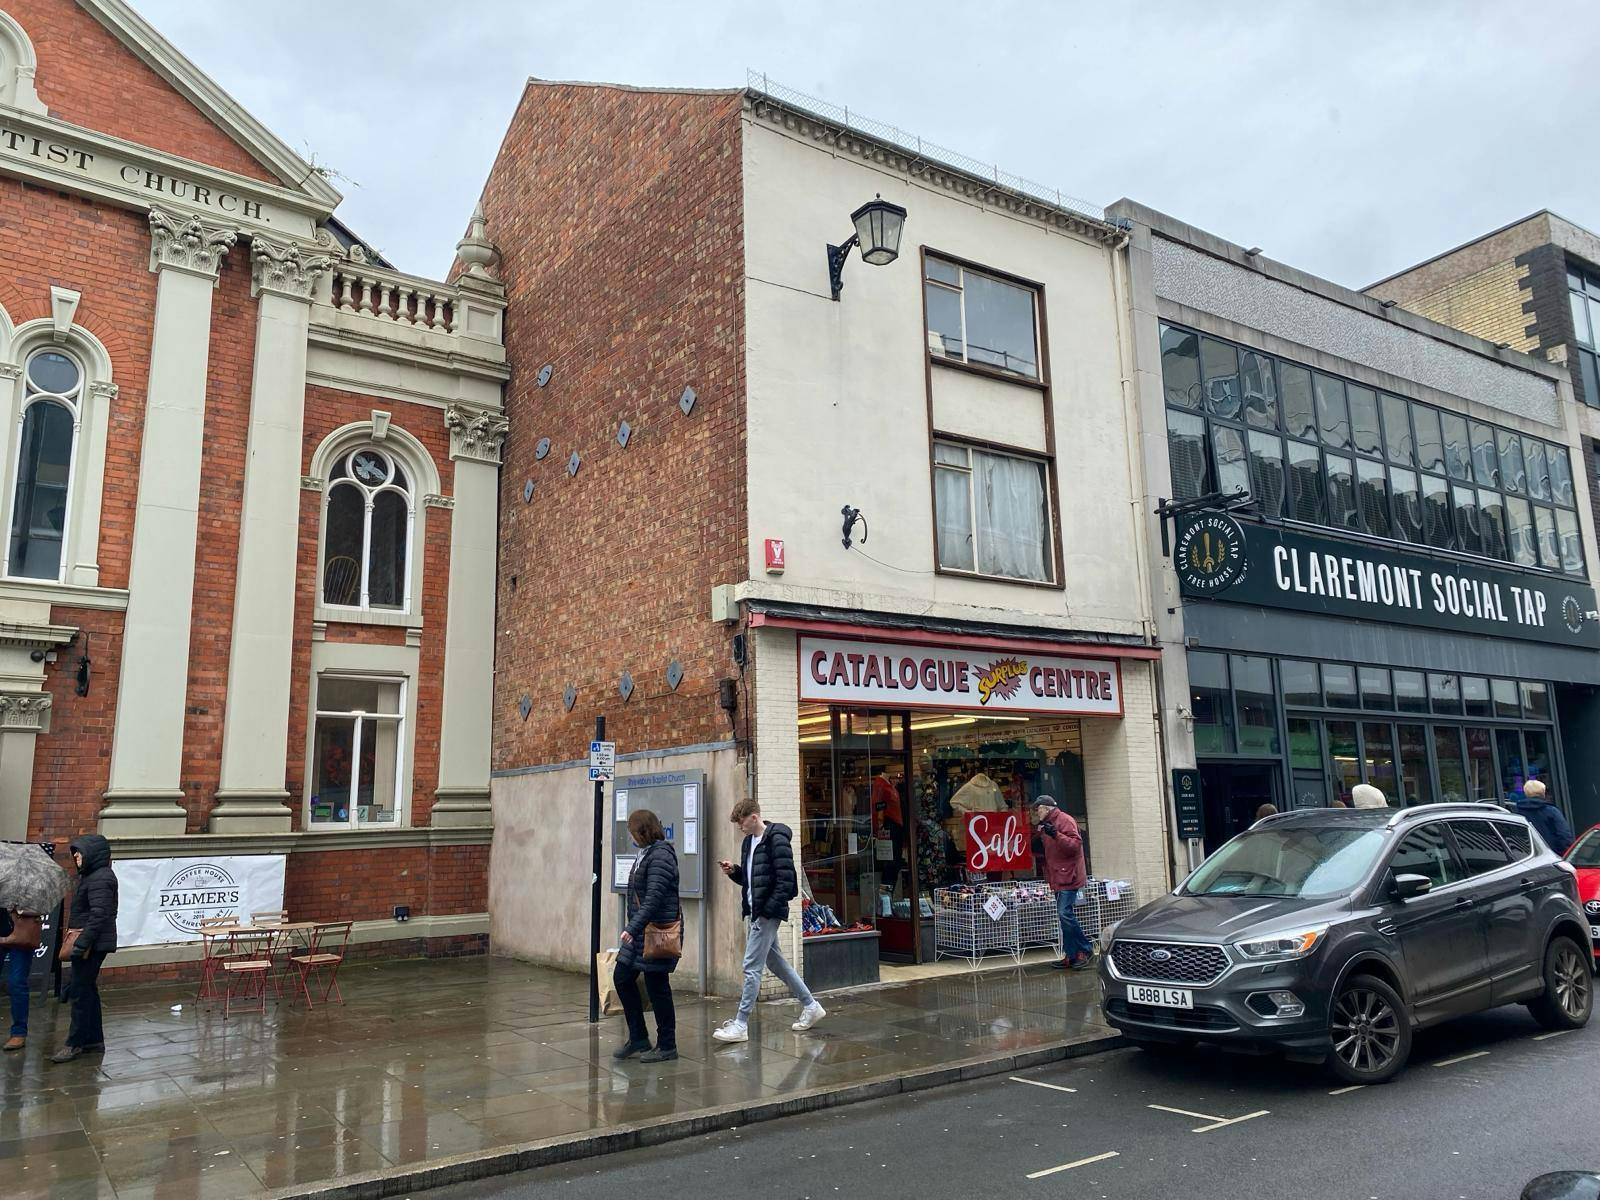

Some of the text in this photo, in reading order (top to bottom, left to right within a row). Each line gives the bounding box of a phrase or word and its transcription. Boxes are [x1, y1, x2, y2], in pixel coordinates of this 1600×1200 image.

[2, 130, 94, 170] TIST
[1179, 518, 1239, 570] CLAREMONT SOCIAL TAP
[1187, 574, 1206, 588] FREE
[1209, 566, 1234, 588] HOUSE
[1273, 545, 1423, 610] CLAREMONT
[1431, 572, 1508, 622] SOCIAL
[1510, 586, 1547, 627] TAP
[811, 650, 1112, 706] CATALOGUE SURPLUS CENTRE
[968, 814, 1027, 870] Sale
[177, 869, 225, 885] COFFEE HOUSE
[160, 890, 239, 907] PALMER'S
[174, 912, 182, 920] OF
[1131, 986, 1188, 1006] L888 LSA
